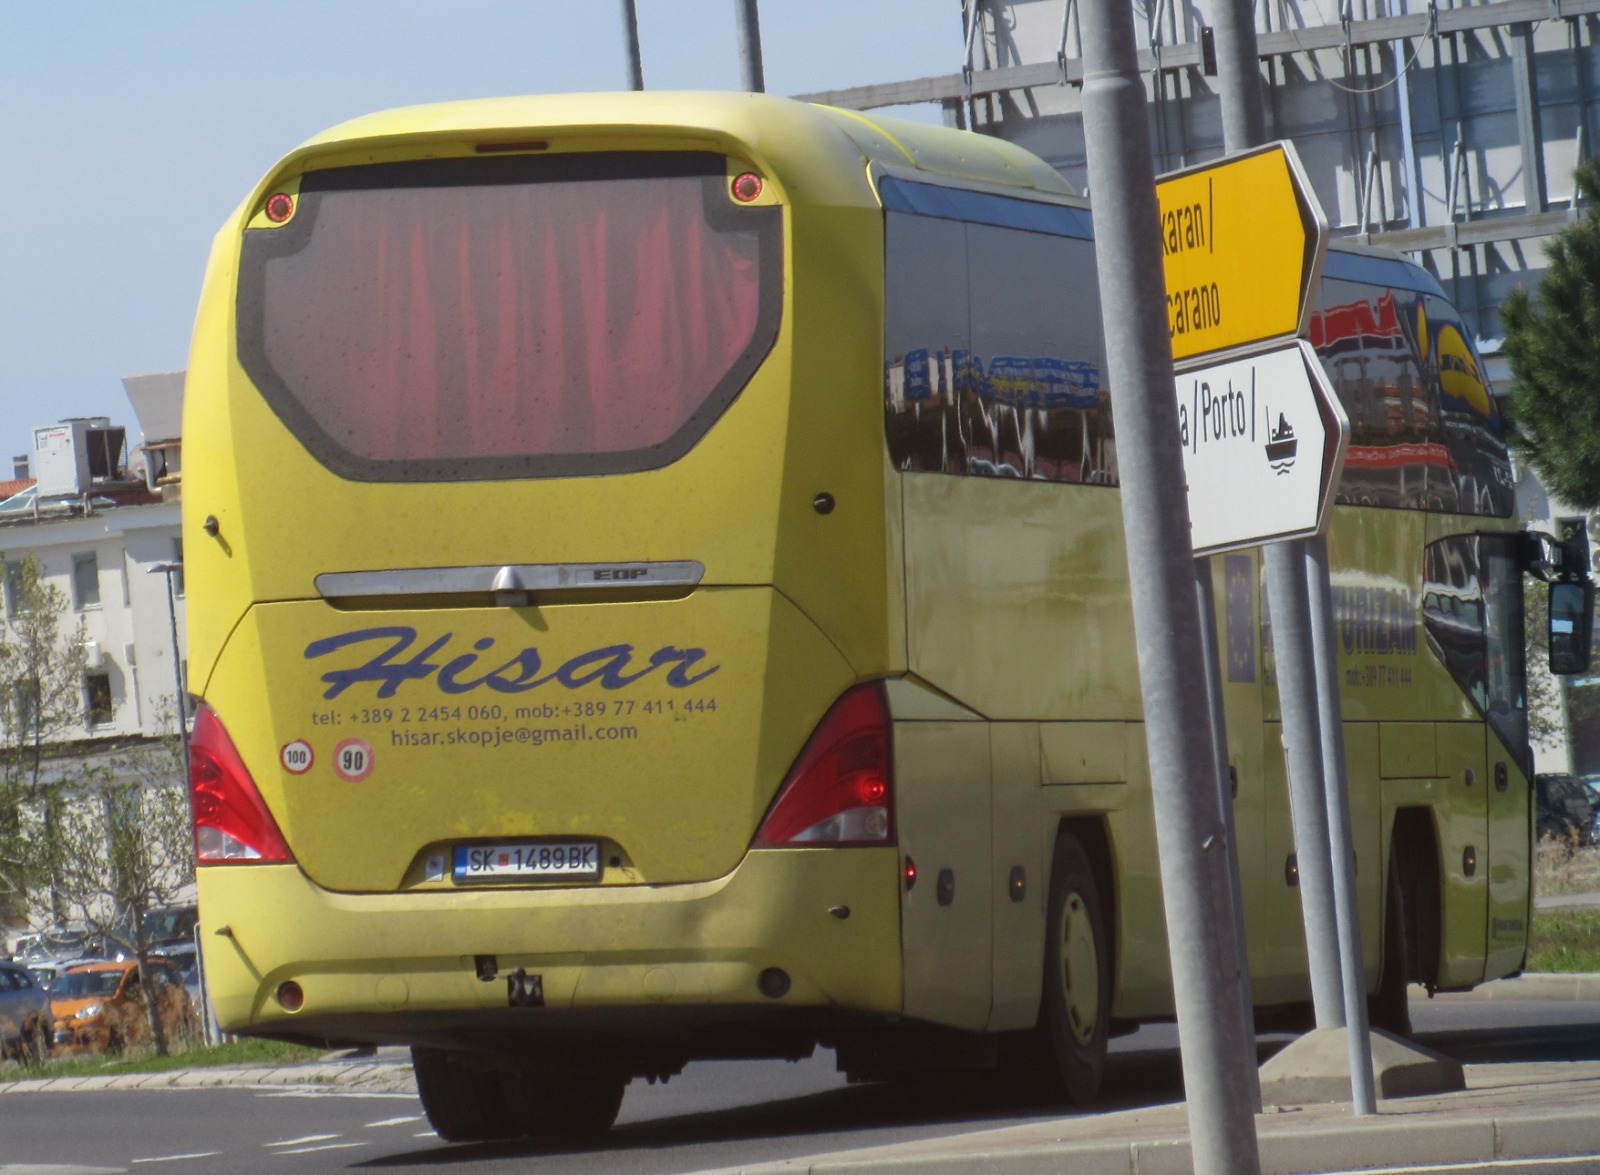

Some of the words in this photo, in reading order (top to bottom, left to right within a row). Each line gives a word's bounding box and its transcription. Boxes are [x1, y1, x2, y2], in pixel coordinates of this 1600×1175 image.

[304, 626, 720, 700] Hisar
[312, 710, 341, 725] tel:
[350, 707, 393, 724] +389
[401, 707, 410, 722] 2
[418, 706, 462, 721] 2454
[468, 704, 508, 722] 060,
[614, 700, 635, 716] 77
[643, 700, 675, 714] 411
[683, 699, 717, 713] 444
[391, 724, 638, 747] hisar.skopje@gmail.com
[286, 750, 307, 764] 100
[343, 750, 364, 771] 90
[470, 849, 494, 872] SK
